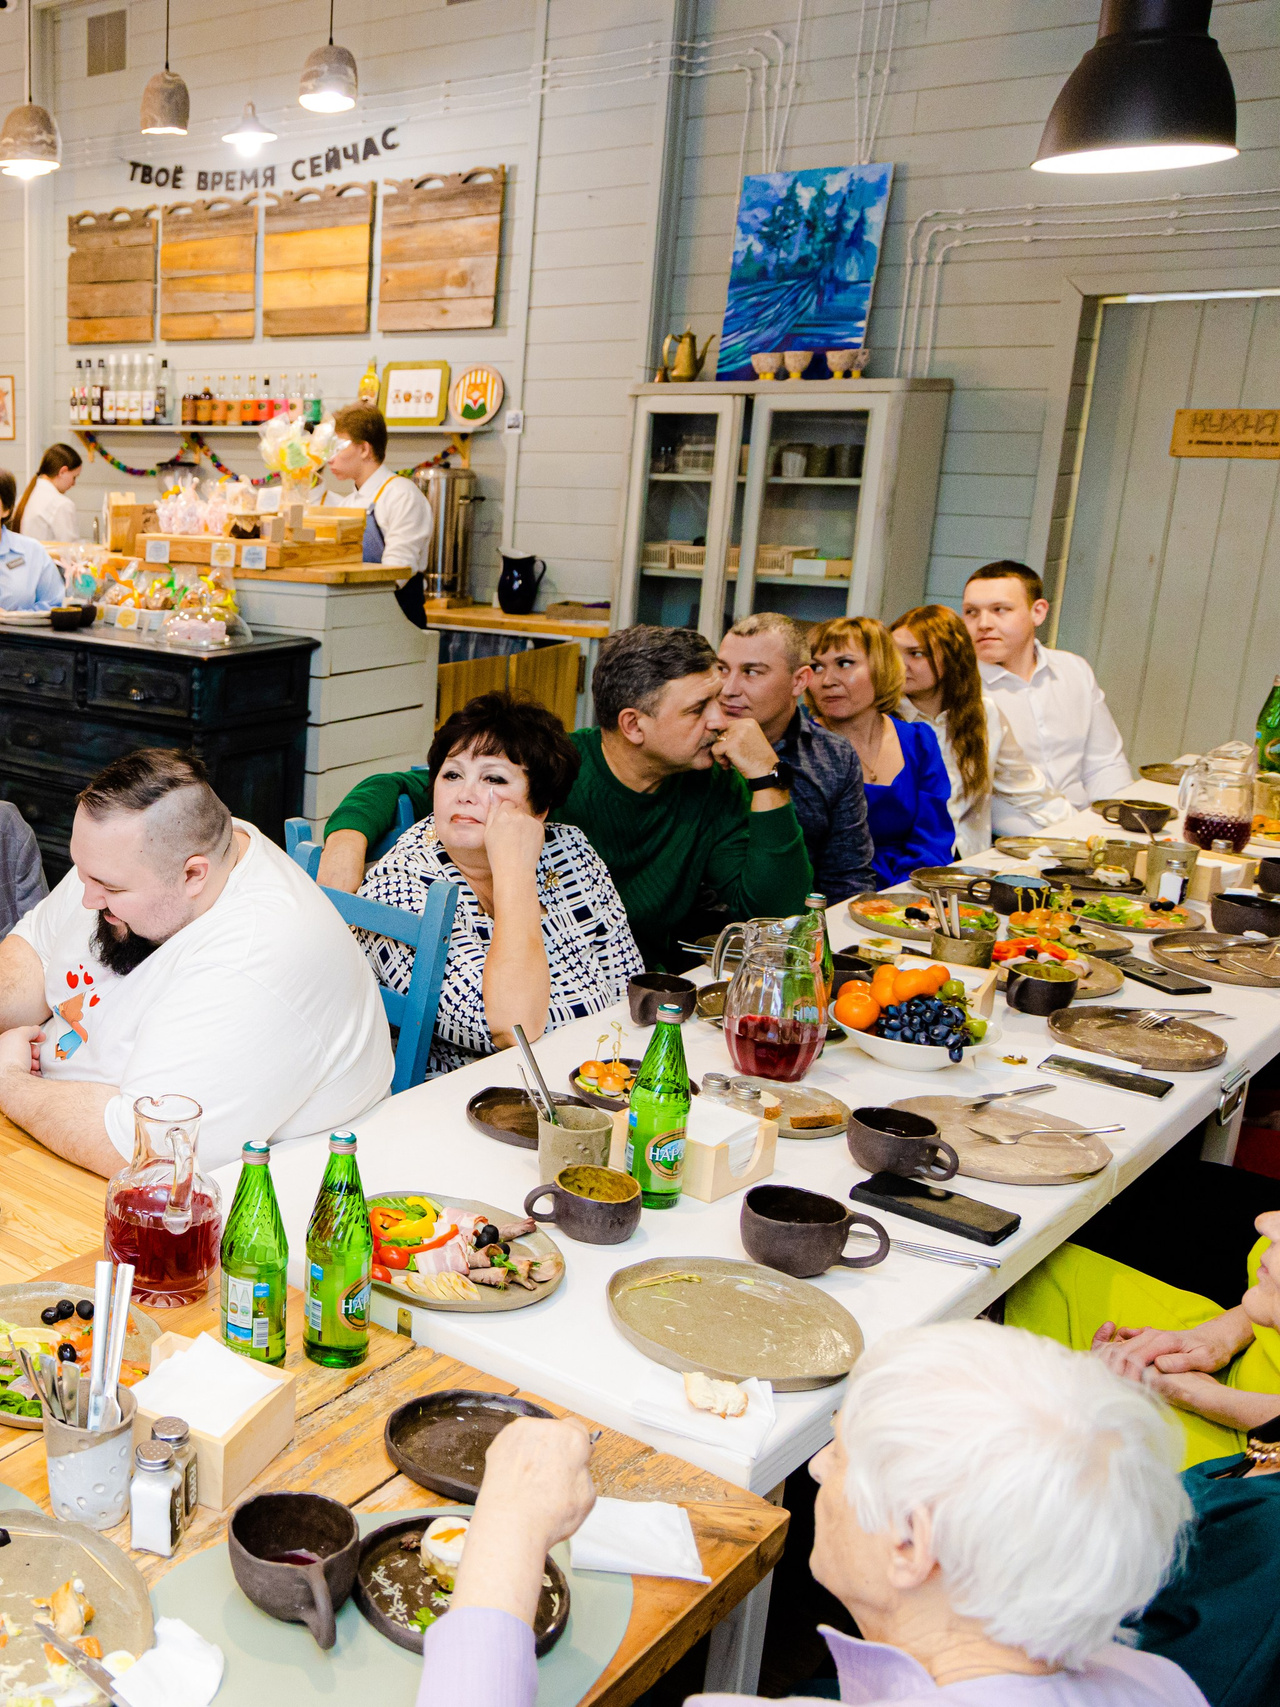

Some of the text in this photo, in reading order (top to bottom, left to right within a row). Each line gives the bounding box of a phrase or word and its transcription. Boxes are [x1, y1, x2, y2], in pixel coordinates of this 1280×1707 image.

[130, 127, 400, 190] ТВОЁ ВРЕМЯ СЕЙЧАС
